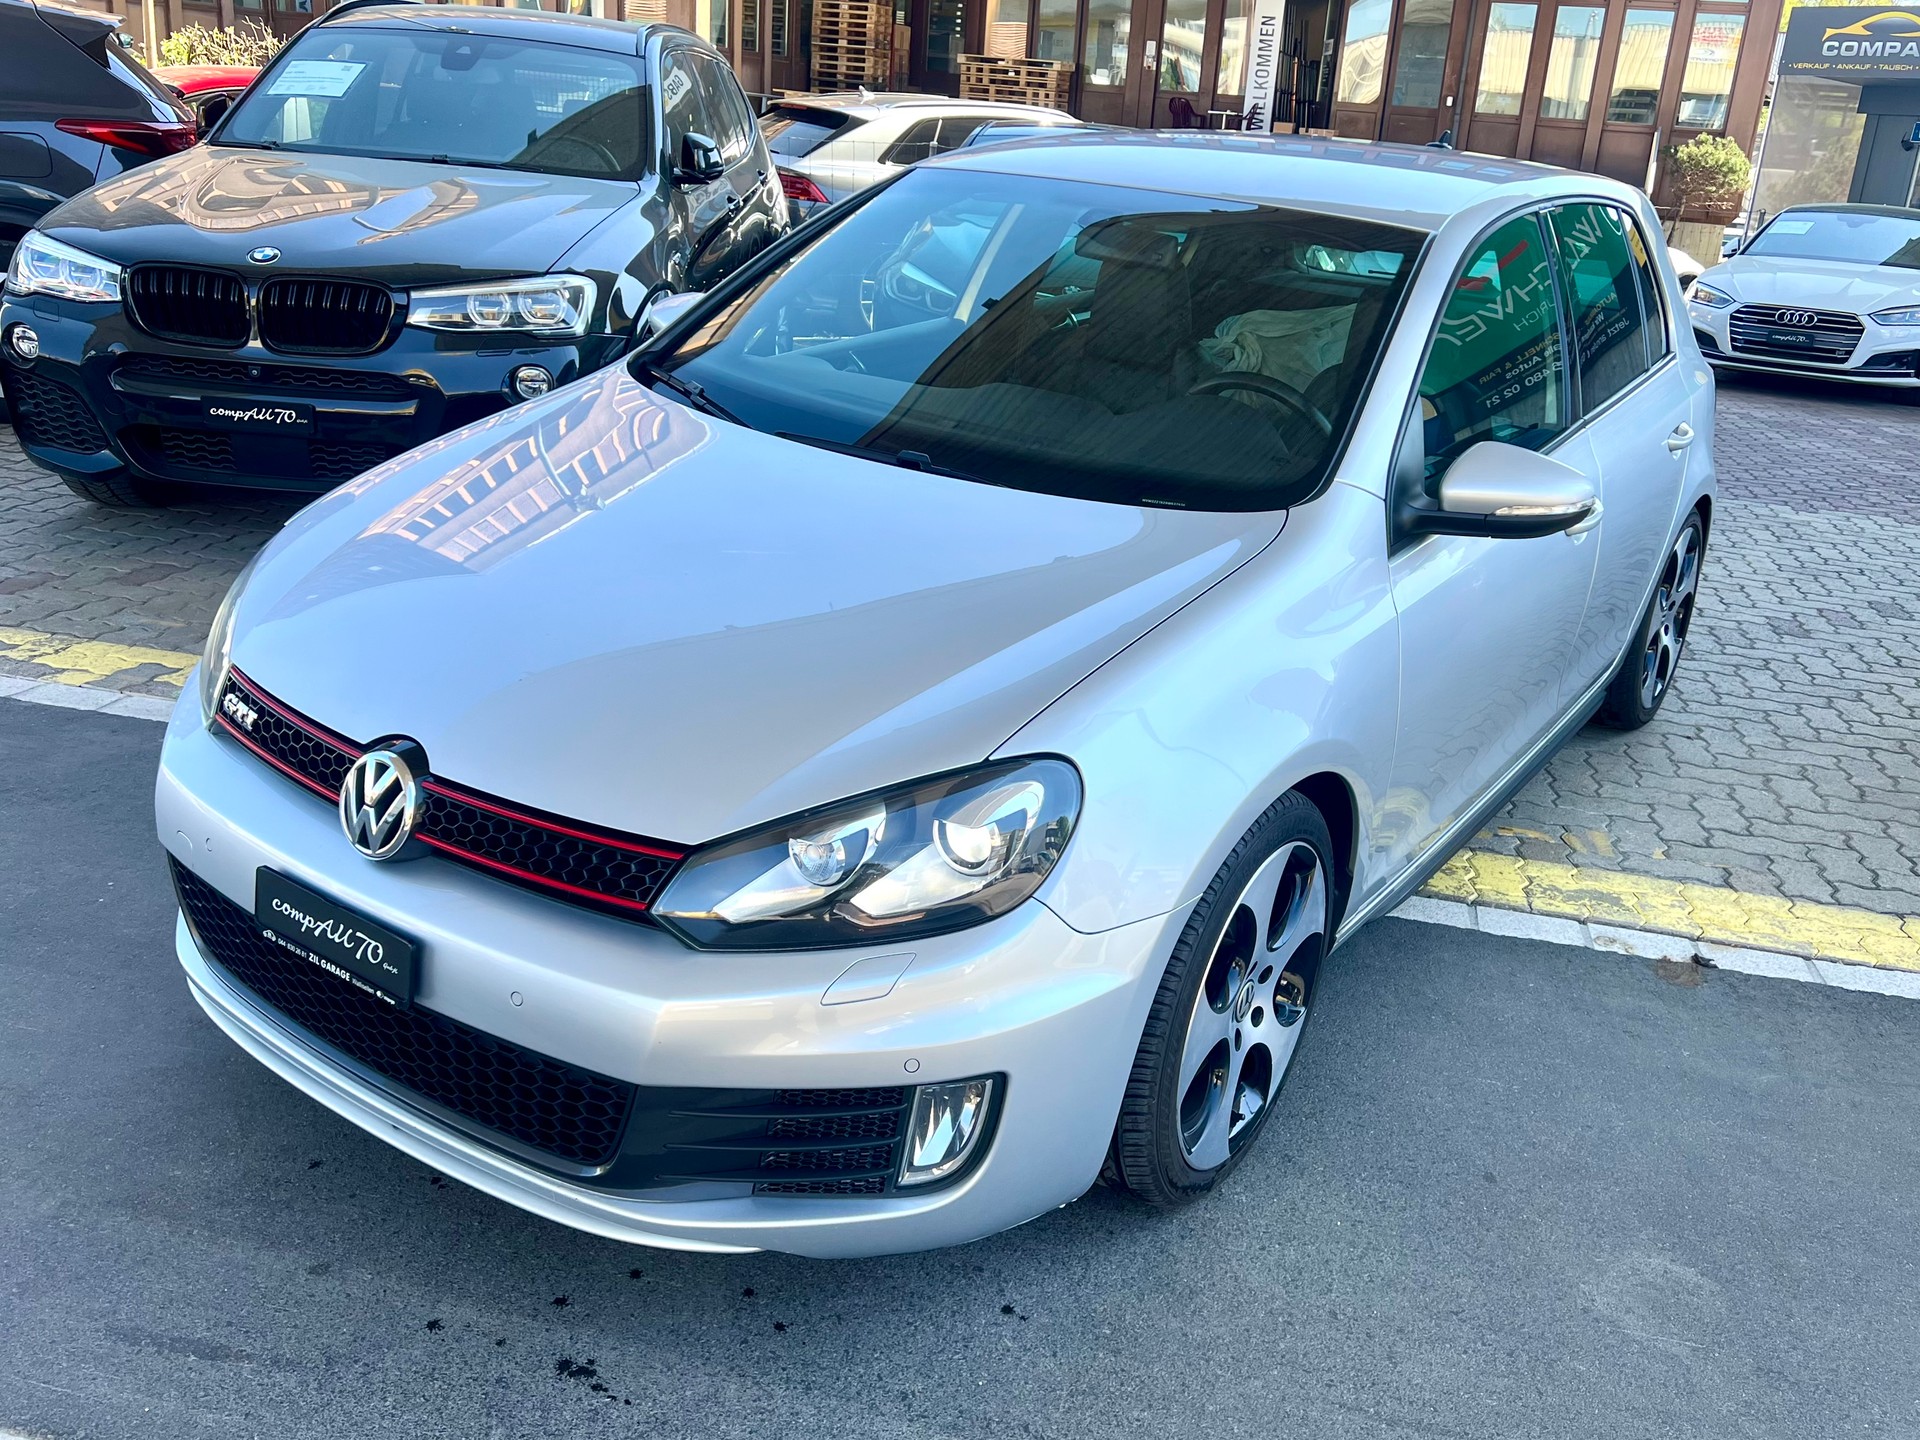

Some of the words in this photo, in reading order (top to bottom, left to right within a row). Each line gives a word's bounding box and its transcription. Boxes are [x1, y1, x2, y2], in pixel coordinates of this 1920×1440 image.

[1251, 16, 1276, 130] WILLKOMMEN
[223, 693, 258, 732] GTI
[308, 952, 320, 966] ZIL
[320, 959, 350, 982] GARAGE
